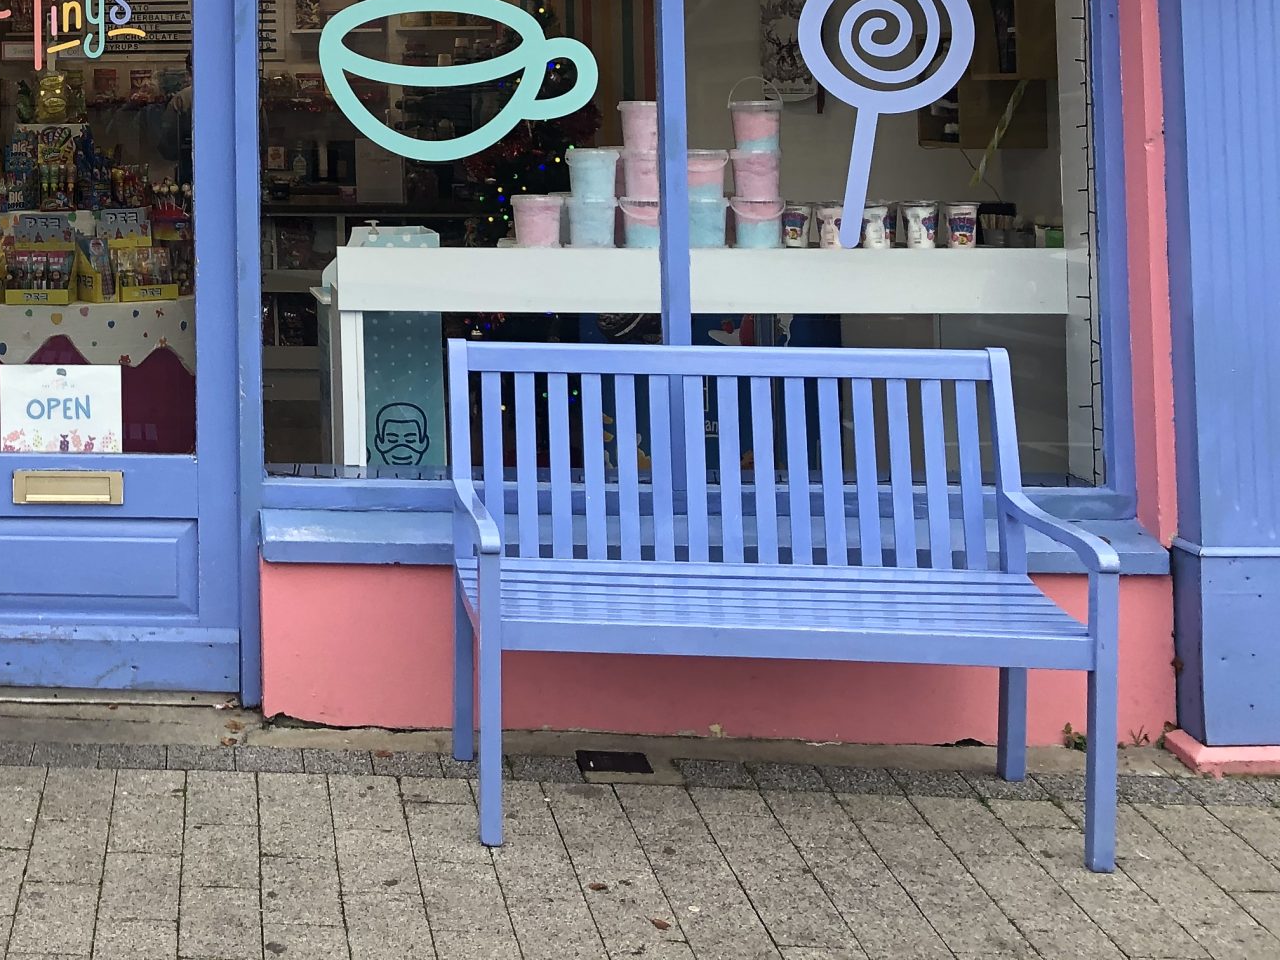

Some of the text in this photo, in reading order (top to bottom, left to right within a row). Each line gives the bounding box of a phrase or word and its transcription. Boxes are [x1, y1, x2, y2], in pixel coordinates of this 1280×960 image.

[25, 217, 61, 229] PEZ
[105, 212, 138, 224] PEZ
[24, 292, 49, 301] PEZ
[26, 394, 91, 420] OPEN
